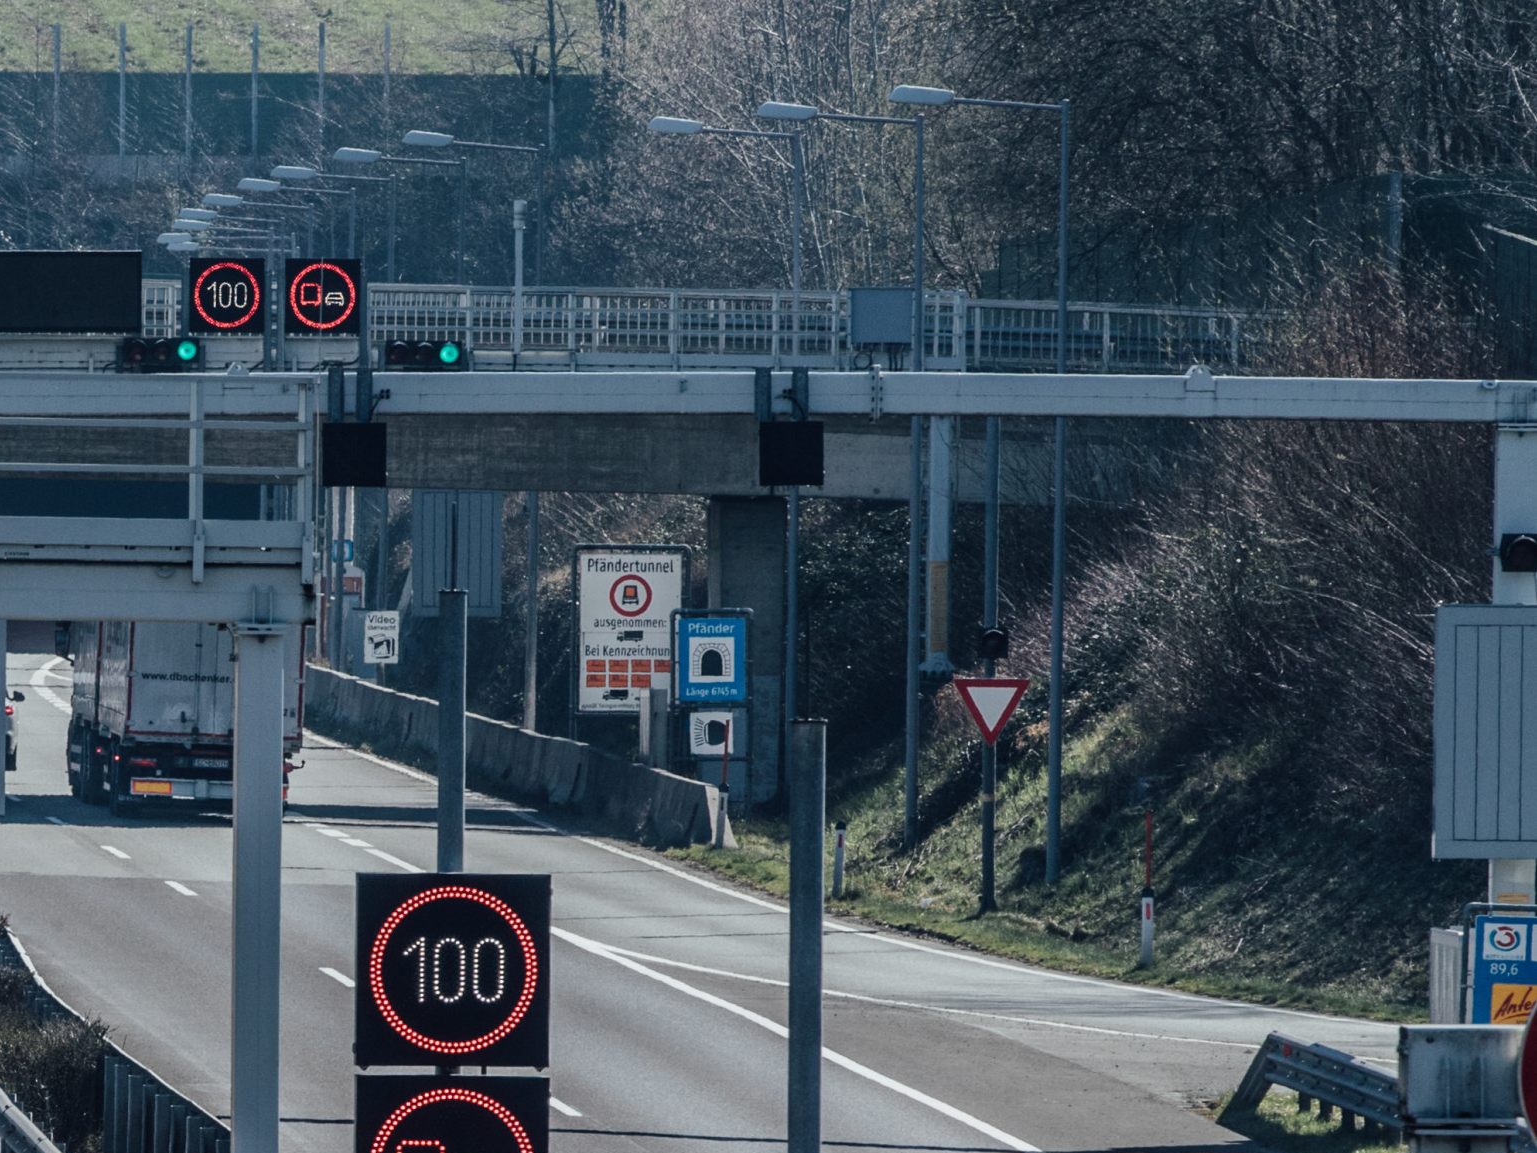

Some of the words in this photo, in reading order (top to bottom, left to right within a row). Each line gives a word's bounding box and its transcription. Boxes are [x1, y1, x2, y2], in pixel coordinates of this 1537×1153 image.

[207, 281, 248, 309] 100
[587, 558, 674, 573] Pfändertunnel
[367, 614, 396, 624] Video
[593, 618, 667, 630] ausgenommen:
[688, 622, 735, 634] Pfänder
[585, 644, 600, 657] Bei
[603, 644, 670, 657] Kennzeichnun
[142, 671, 234, 684] www.dbschenker.
[686, 687, 710, 698] Länge
[403, 937, 505, 1002] 100
[1490, 962, 1519, 977] 89,6
[1493, 986, 1536, 1020] Ante
